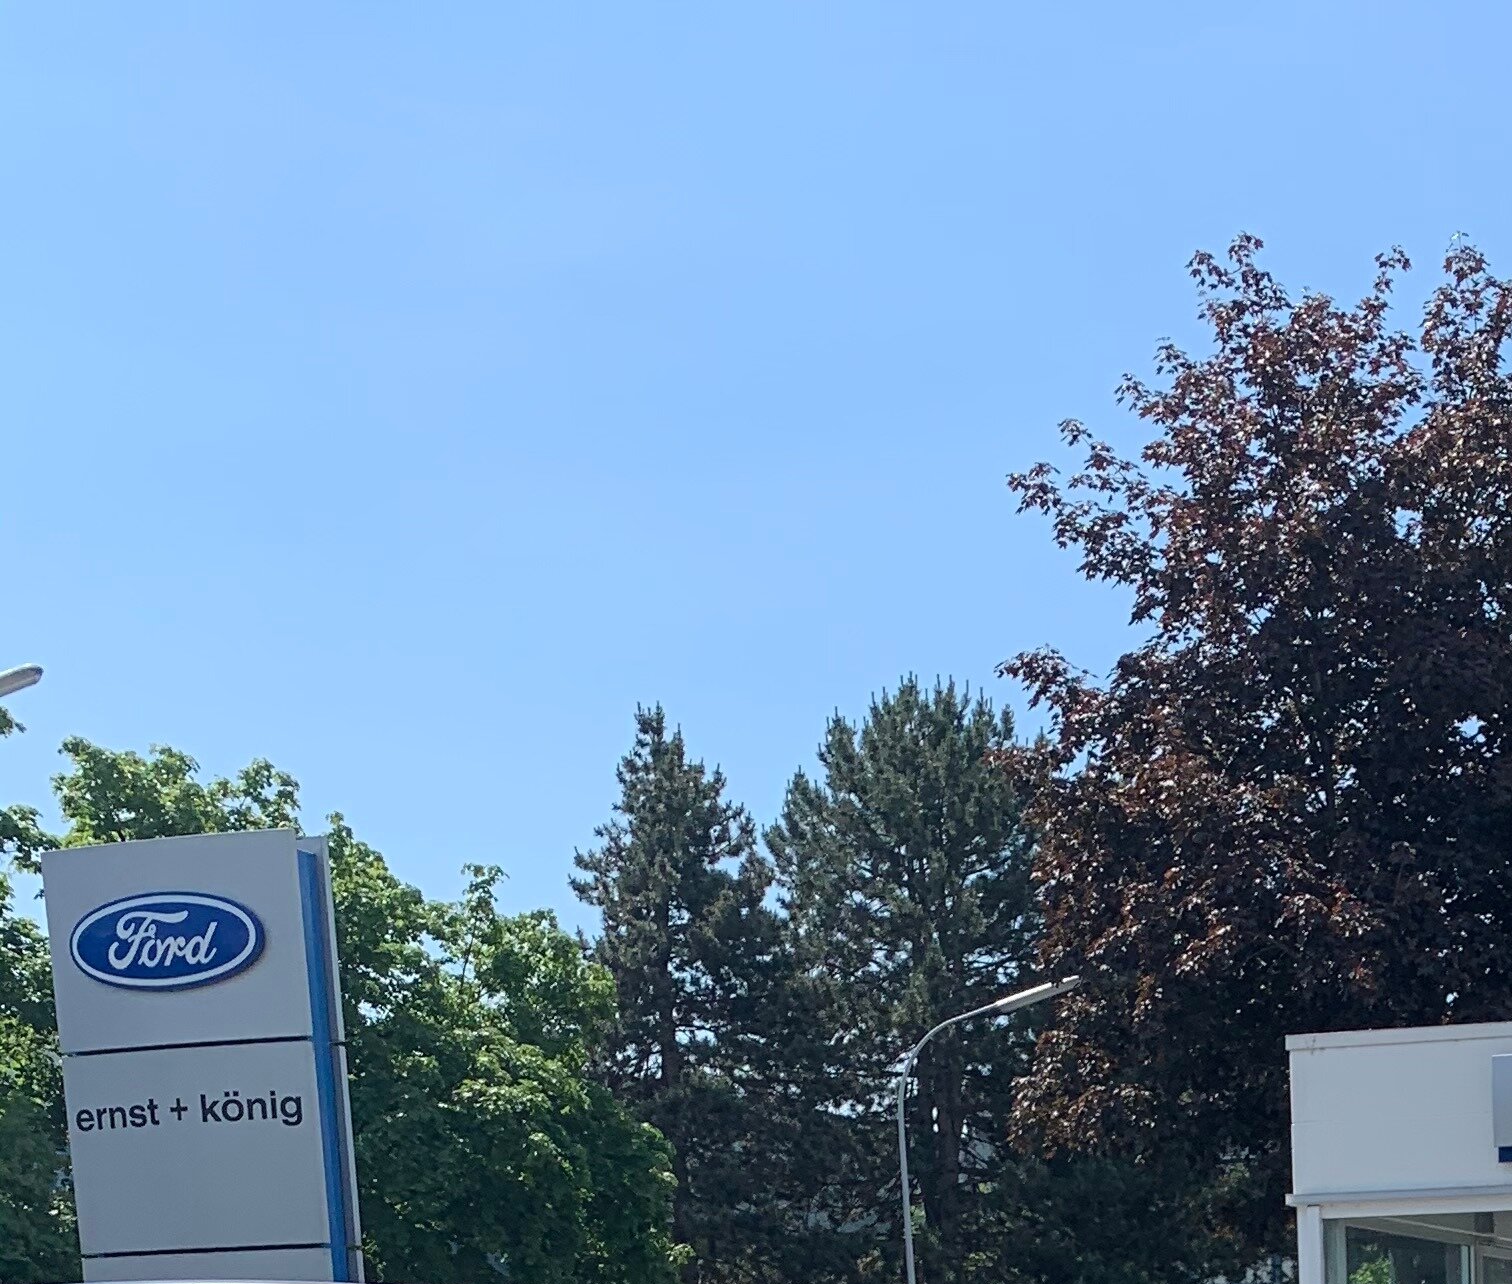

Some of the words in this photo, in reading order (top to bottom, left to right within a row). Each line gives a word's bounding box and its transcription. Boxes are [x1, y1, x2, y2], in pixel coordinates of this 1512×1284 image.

[109, 910, 217, 970] Ford
[75, 1099, 160, 1131] ernst
[170, 1097, 188, 1122] +
[200, 1089, 304, 1126] könig
